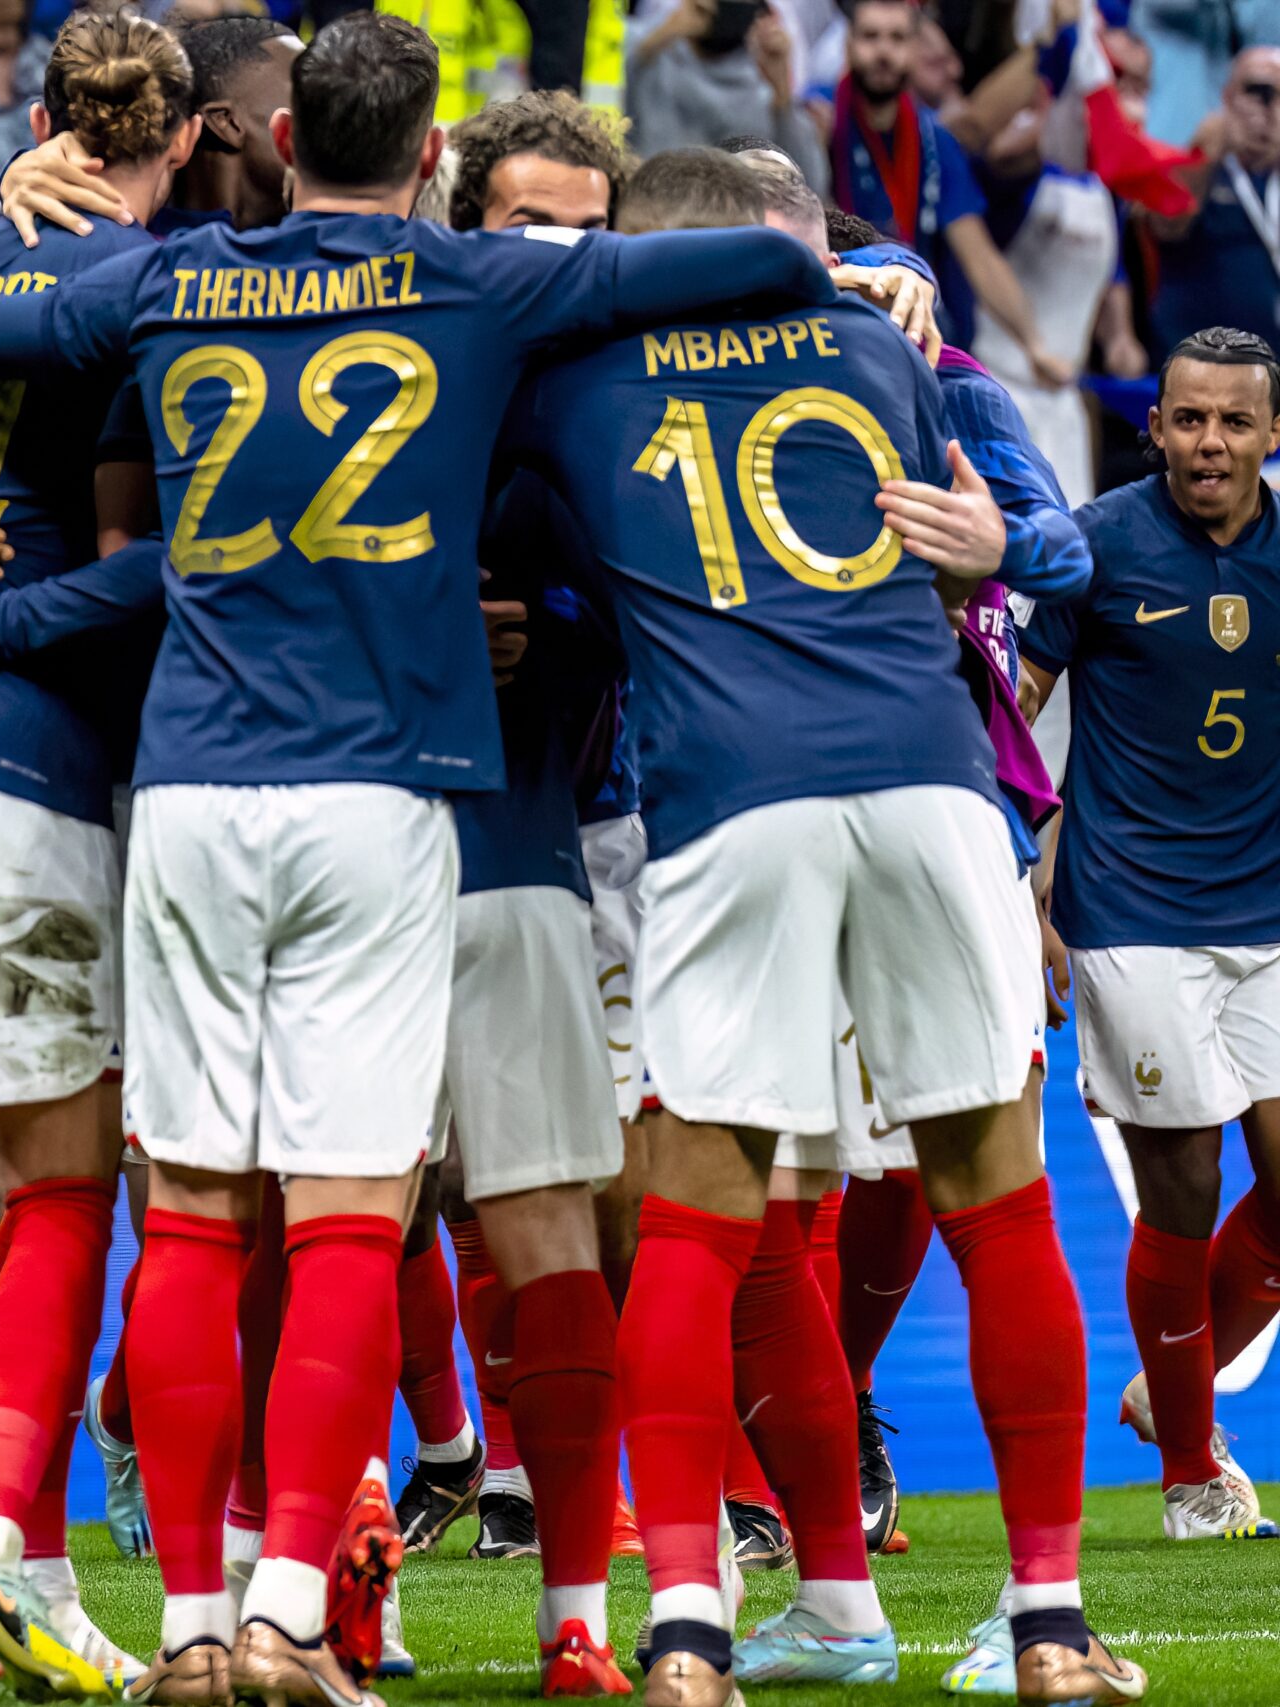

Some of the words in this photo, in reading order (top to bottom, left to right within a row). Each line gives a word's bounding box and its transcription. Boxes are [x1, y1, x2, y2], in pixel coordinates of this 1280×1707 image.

[172, 250, 422, 319] T.HERNANDEZ
[642, 317, 840, 376] MBAPPE
[161, 330, 438, 580] 22
[632, 386, 907, 610] 10
[1197, 689, 1246, 759] 5
